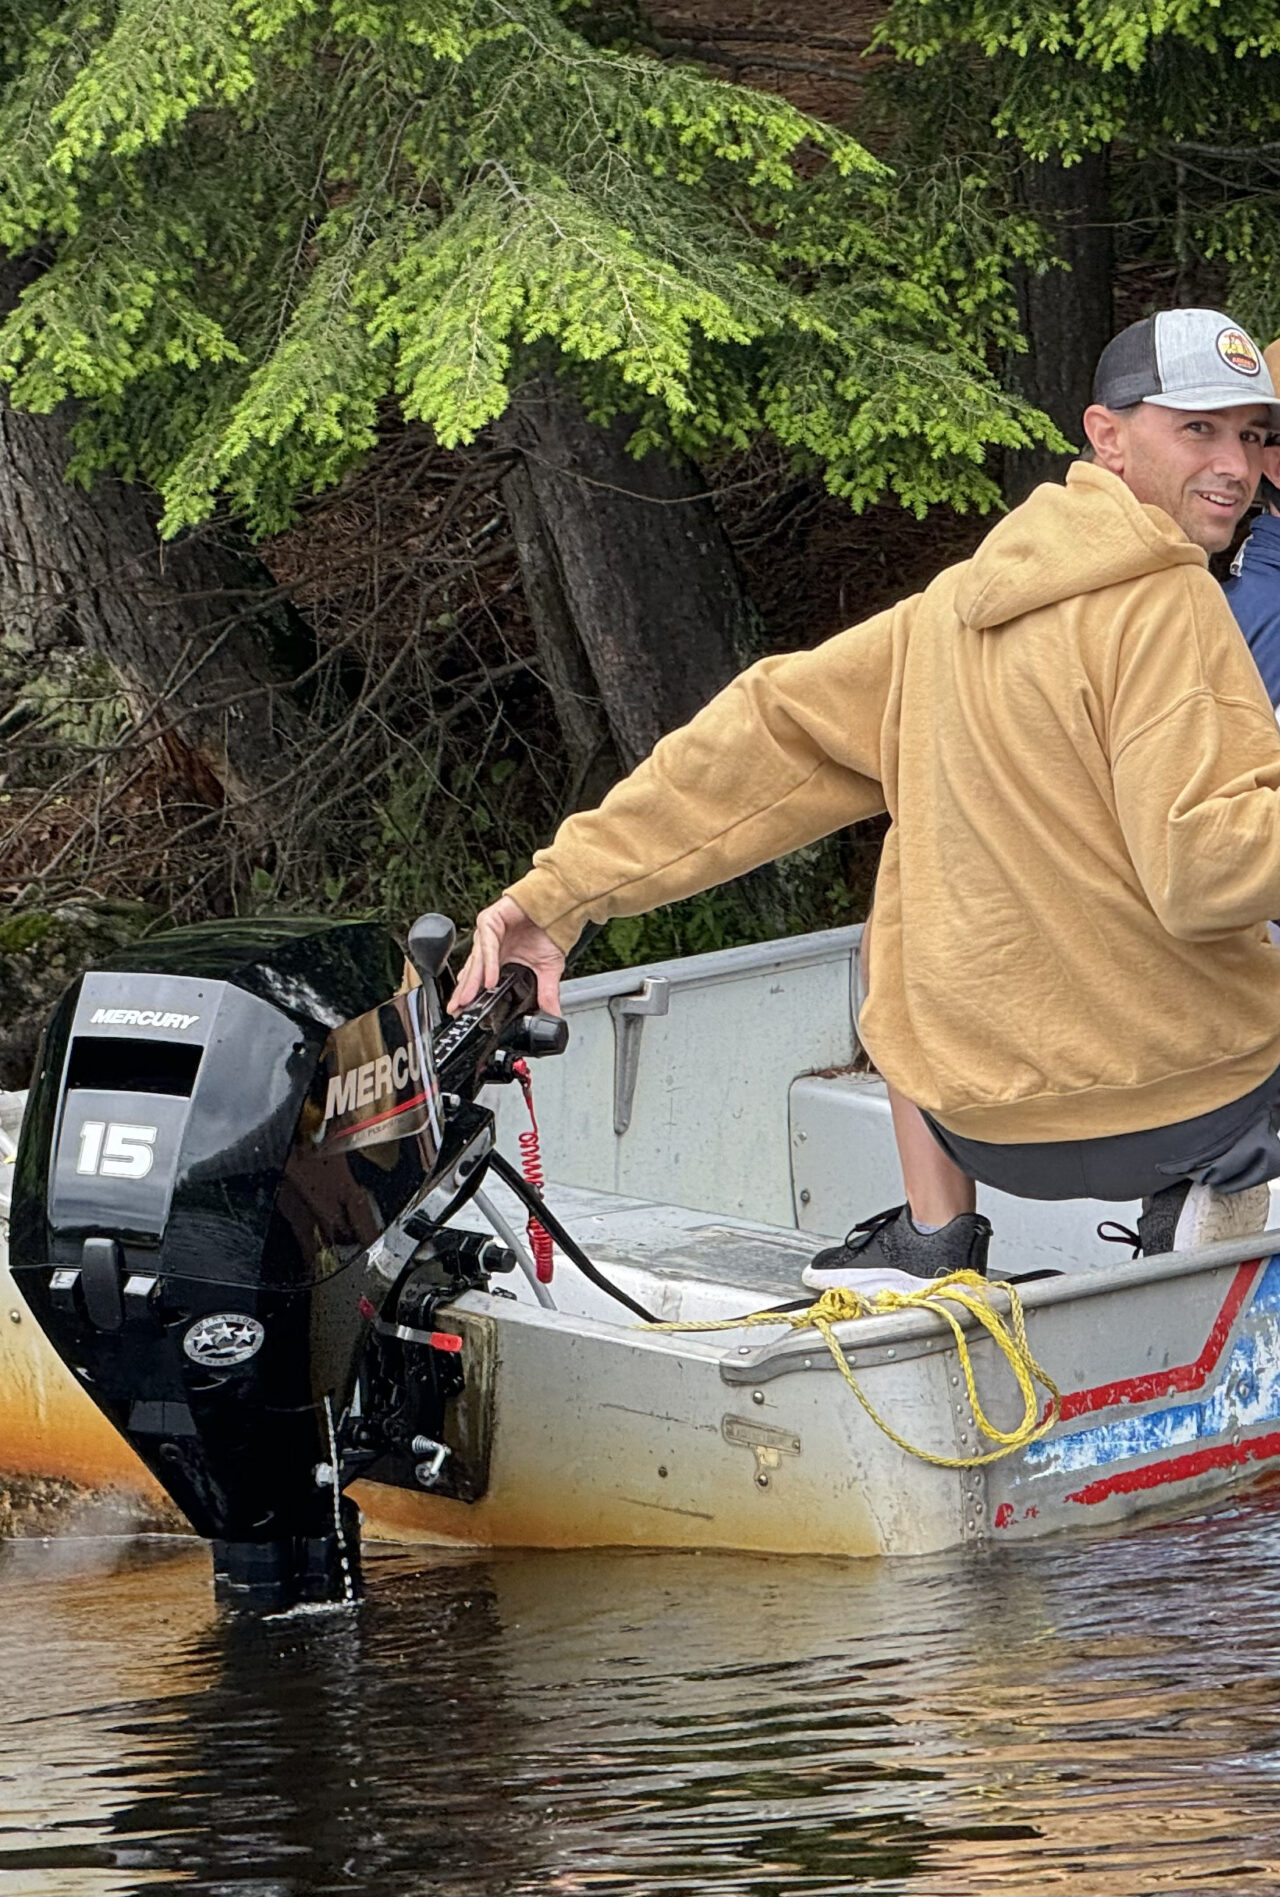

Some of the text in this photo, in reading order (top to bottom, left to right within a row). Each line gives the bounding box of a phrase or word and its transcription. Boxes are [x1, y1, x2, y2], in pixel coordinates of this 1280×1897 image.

[91, 1009, 200, 1029] MERCURY
[325, 1042, 421, 1120] MERCU
[77, 1121, 158, 1179] 15
